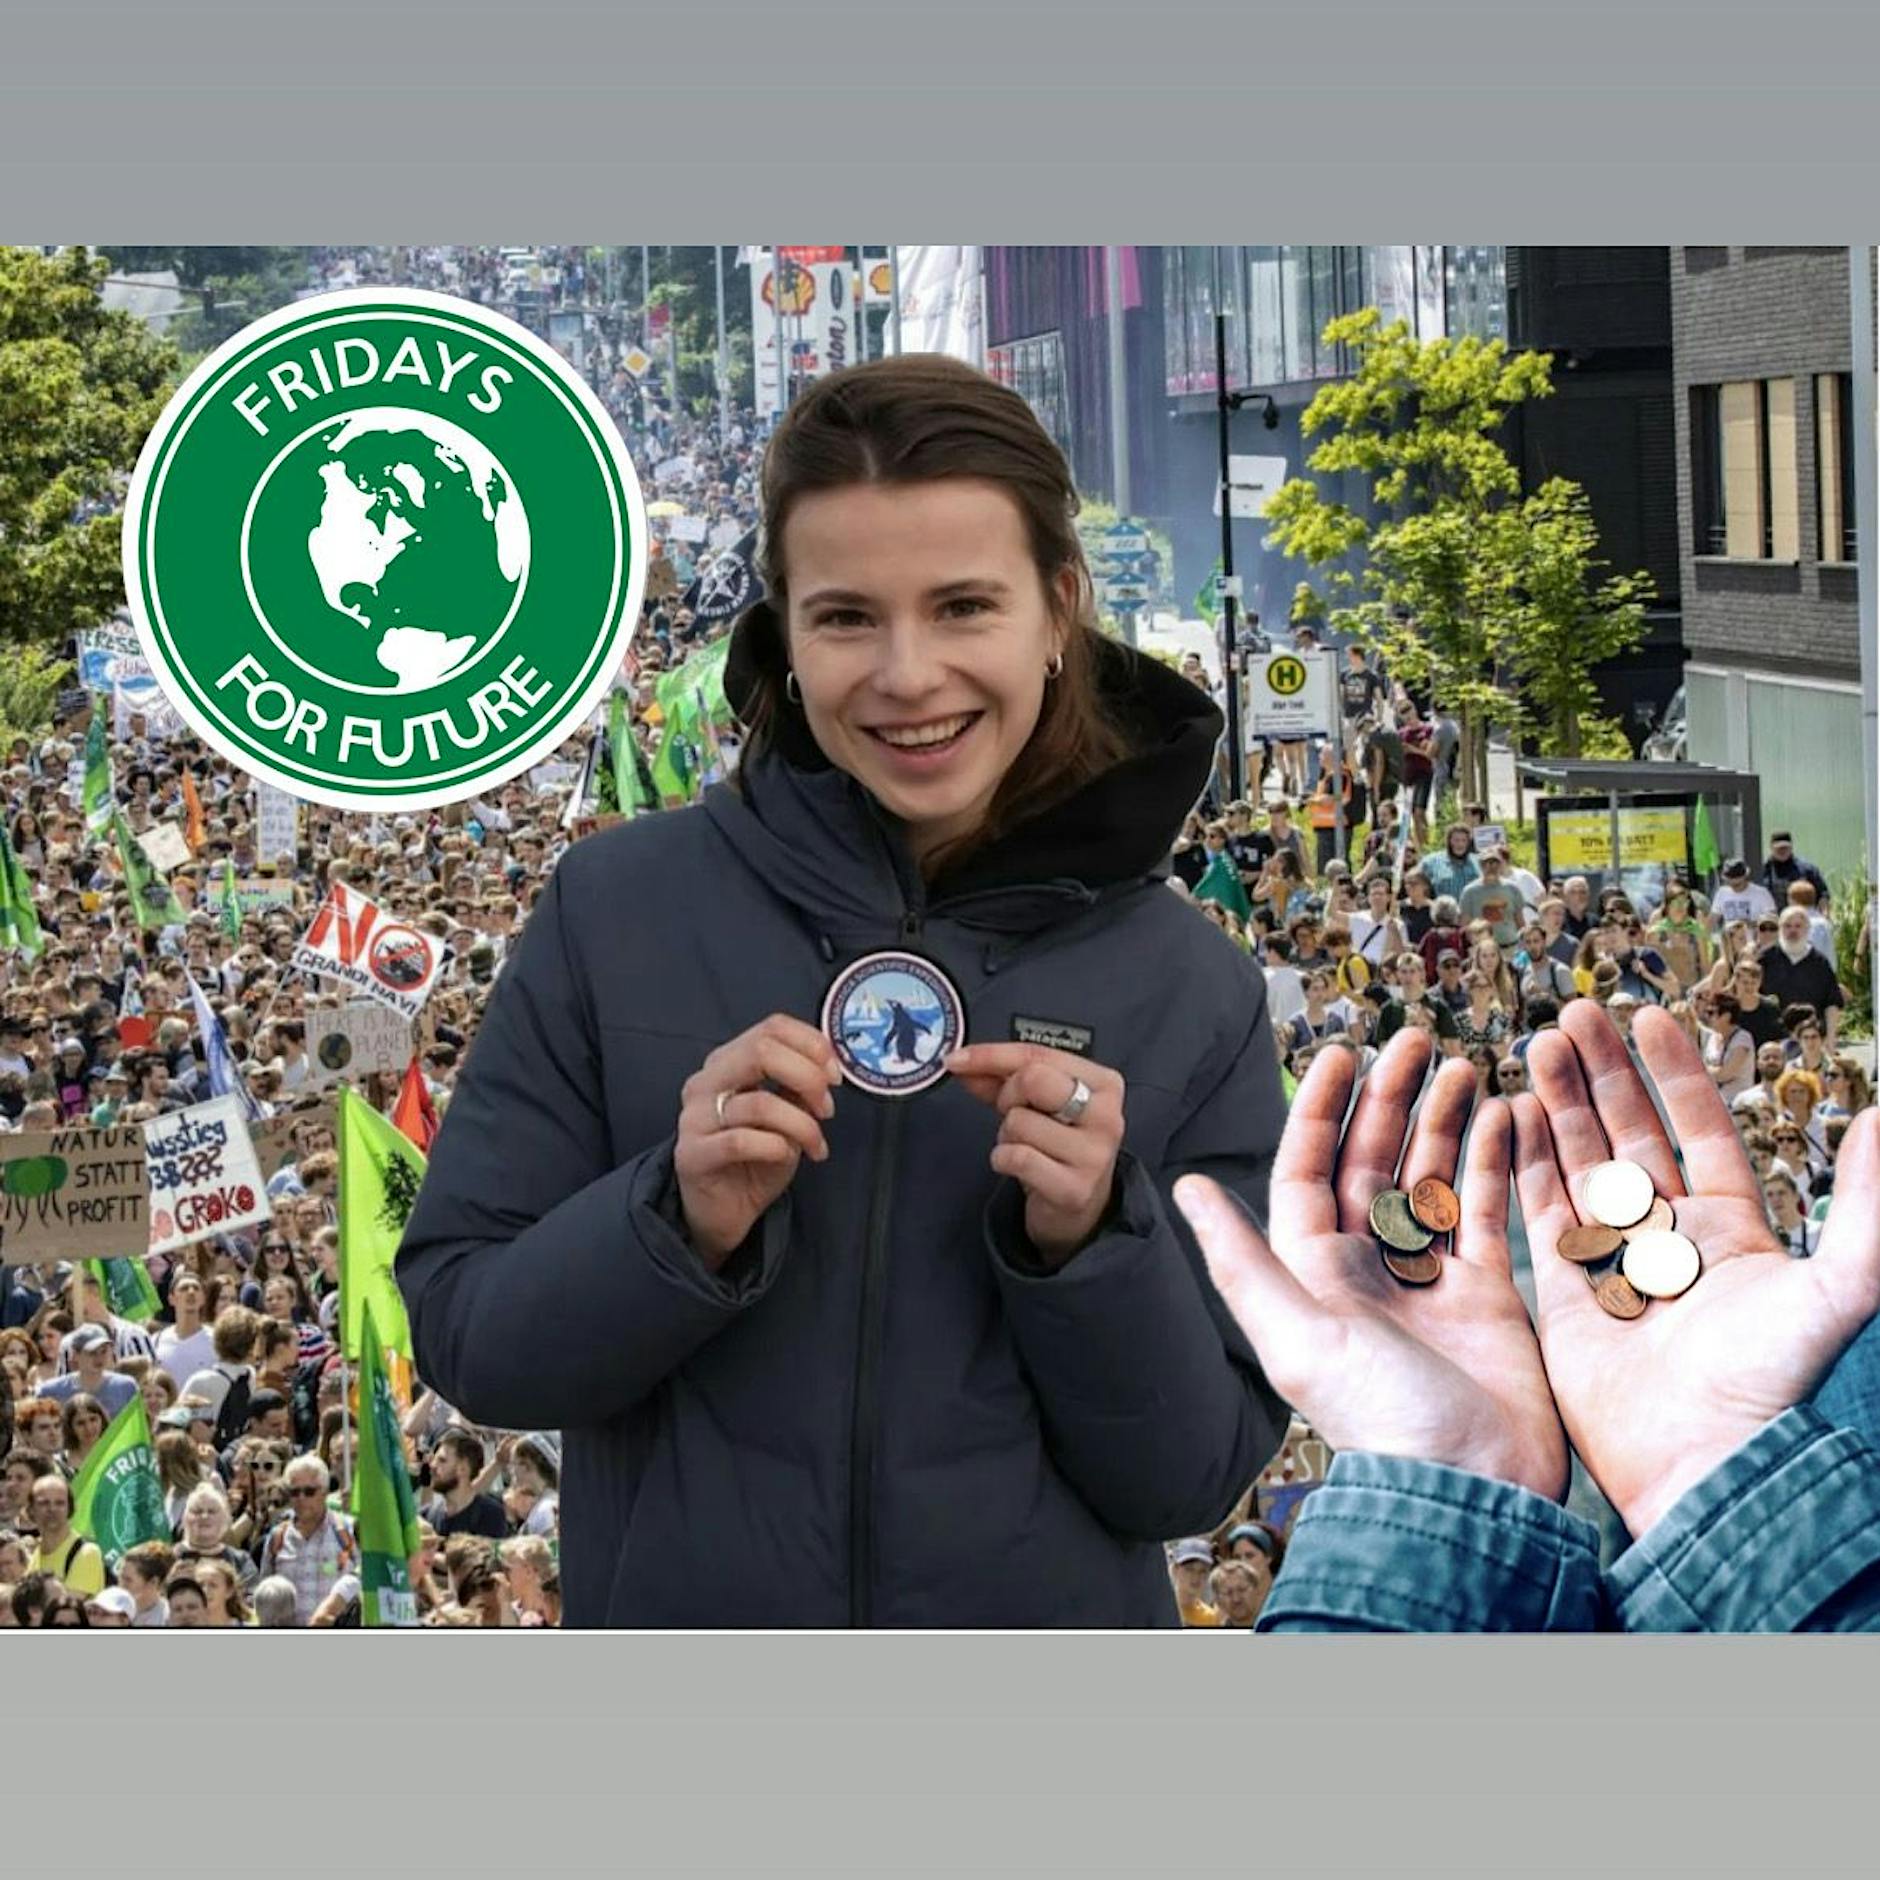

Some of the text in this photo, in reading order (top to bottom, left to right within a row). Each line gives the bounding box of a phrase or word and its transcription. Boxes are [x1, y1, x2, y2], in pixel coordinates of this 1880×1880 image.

[1277, 665, 1296, 687] H
[296, 950, 417, 1015] GRANDI NAVI
[51, 1128, 138, 1153] NATUR
[145, 1114, 228, 1160] usstieg
[75, 1160, 145, 1188] STATT
[67, 1194, 143, 1227] PROFIT
[174, 1184, 255, 1234] GROKO
